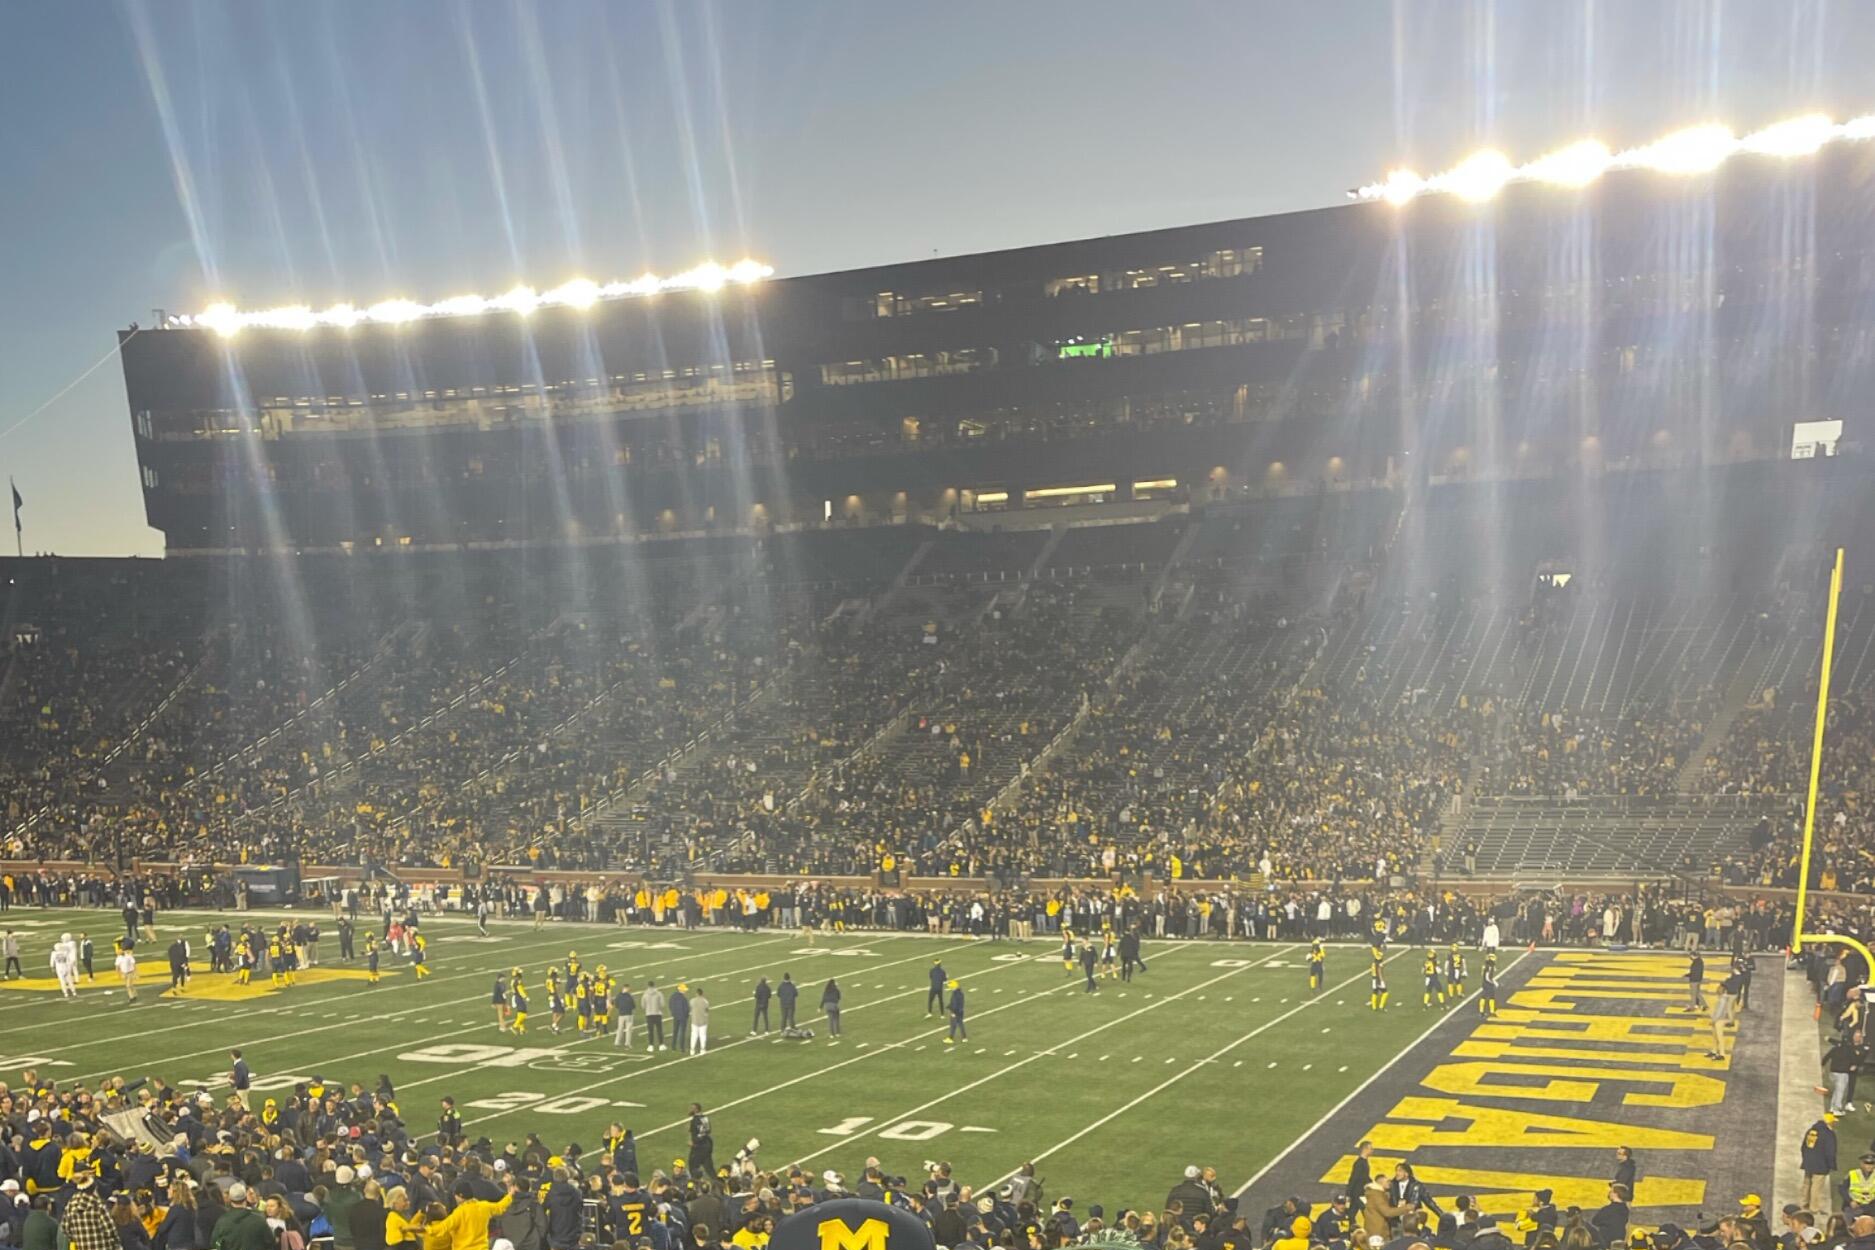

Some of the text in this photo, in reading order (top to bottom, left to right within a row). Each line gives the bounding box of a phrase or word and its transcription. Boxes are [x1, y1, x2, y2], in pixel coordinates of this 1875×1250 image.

[464, 1092, 610, 1113] 20
[1306, 953, 1742, 1245] MICHIGAN
[816, 1116, 954, 1141] 10
